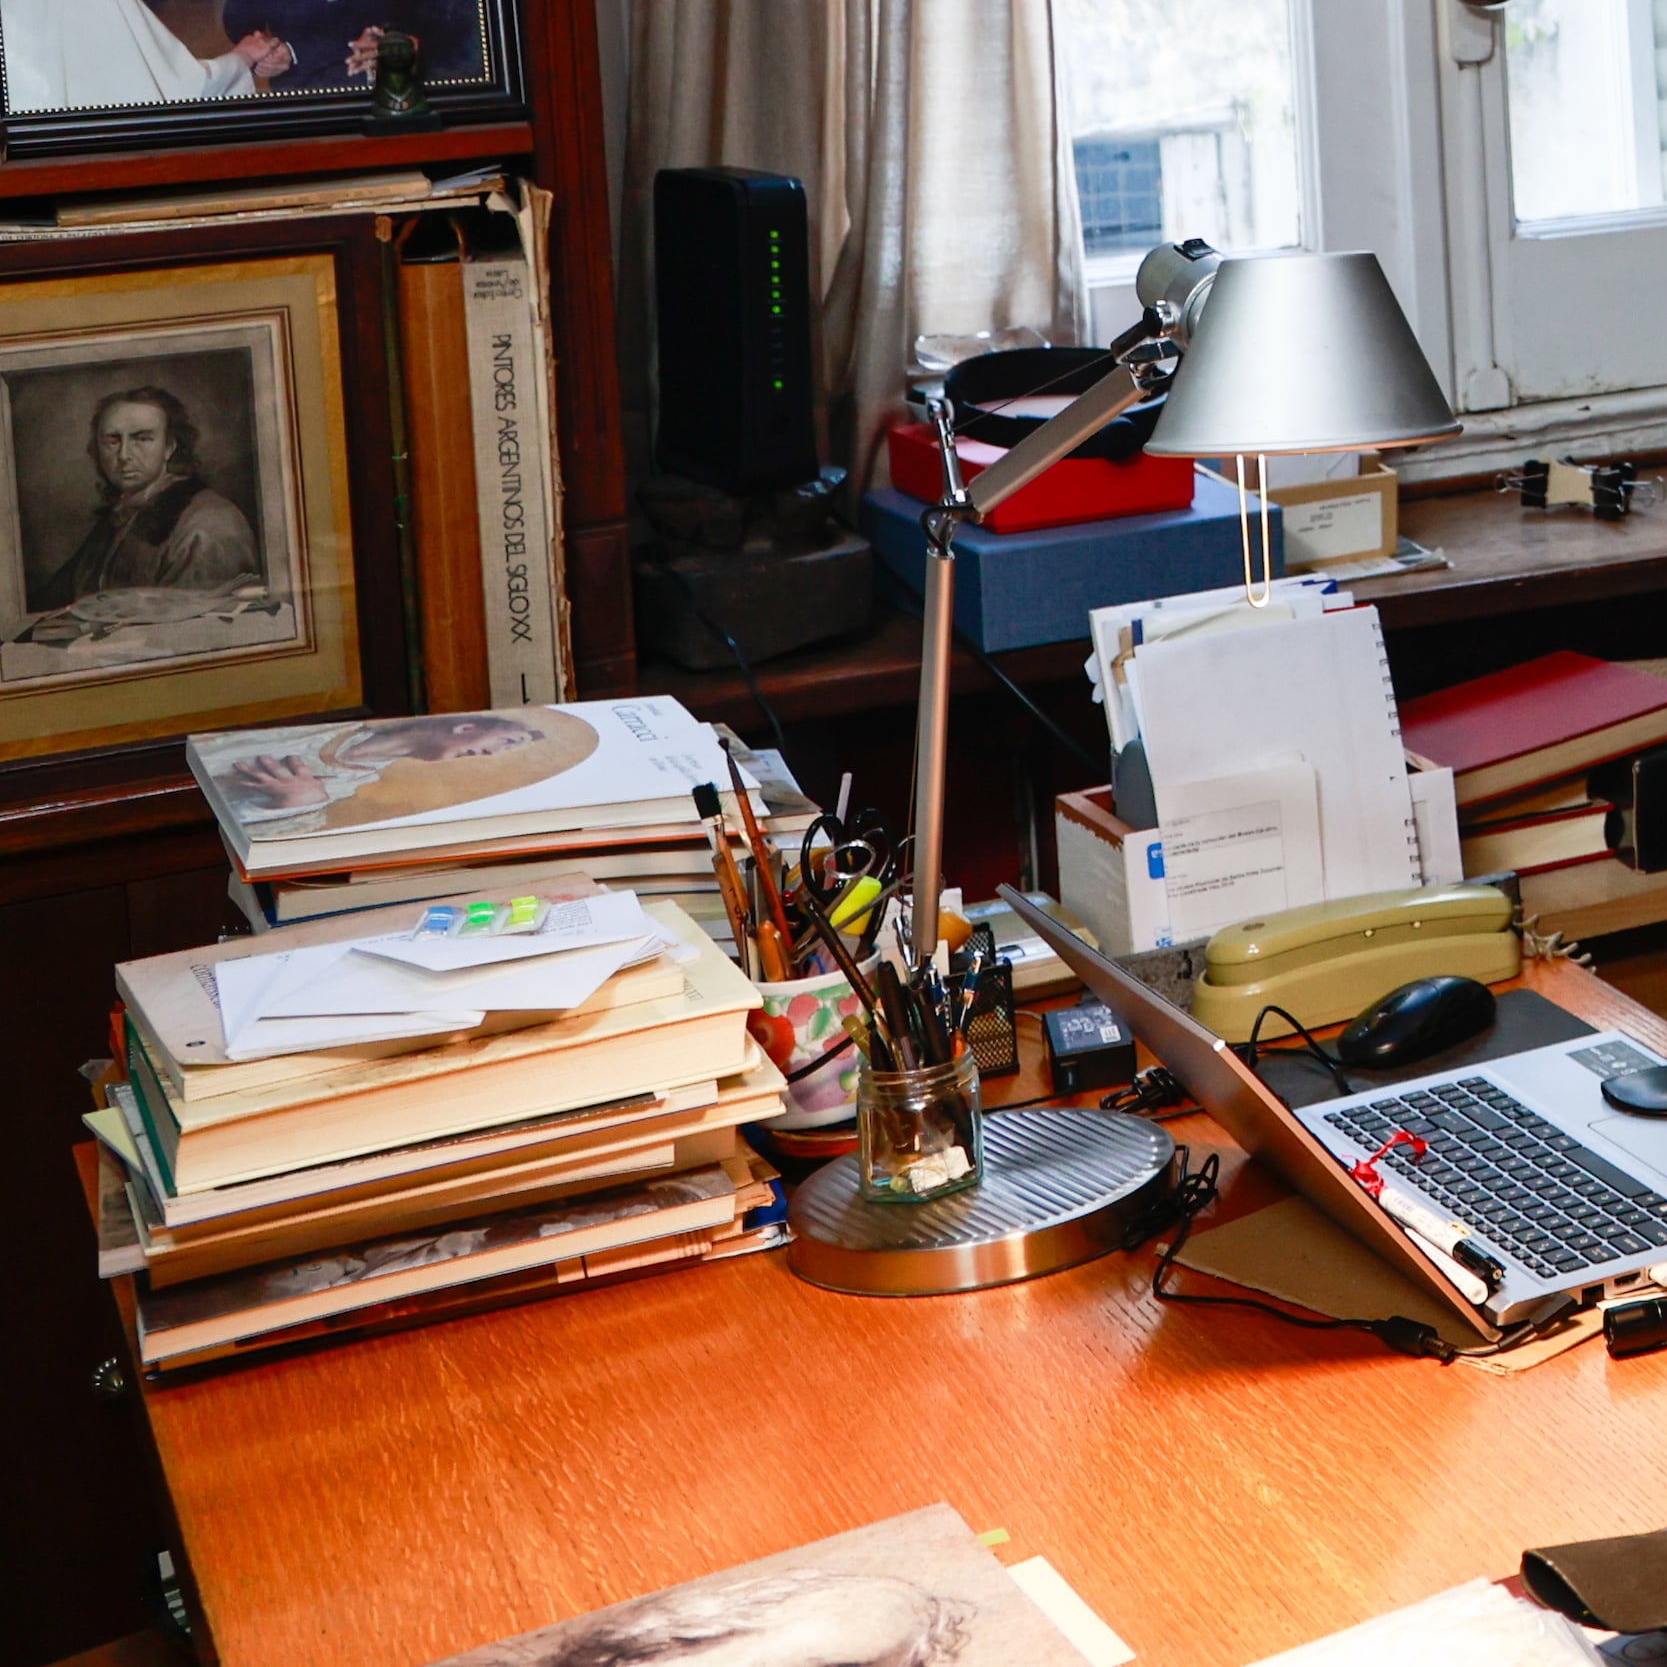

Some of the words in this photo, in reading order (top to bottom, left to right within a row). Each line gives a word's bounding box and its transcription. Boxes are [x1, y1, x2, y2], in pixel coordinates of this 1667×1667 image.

[491, 334, 516, 411] PINTORES
[497, 416, 524, 529] ARGENTINOS
[503, 533, 526, 562] DEL
[506, 564, 530, 615] SIGLO
[509, 614, 533, 644] XX
